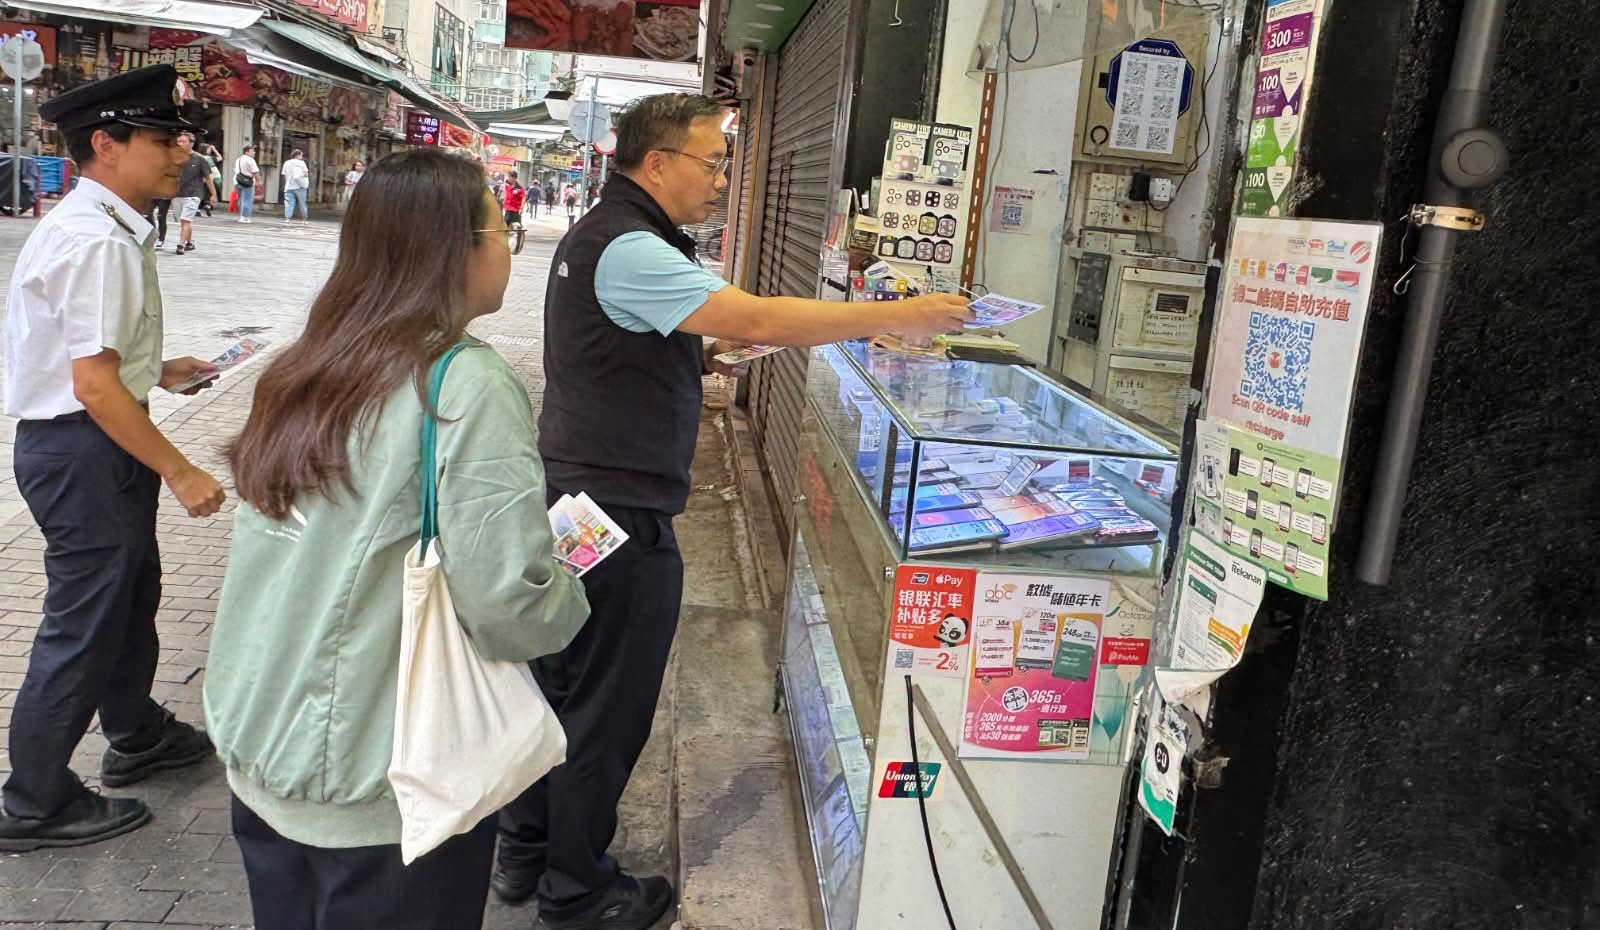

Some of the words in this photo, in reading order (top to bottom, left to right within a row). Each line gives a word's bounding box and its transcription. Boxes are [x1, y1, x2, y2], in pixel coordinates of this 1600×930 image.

[342, 2, 366, 25] SHOP
[1267, 29, 1292, 50] $300
[1258, 74, 1279, 93] $100
[1231, 393, 1250, 410] Scan
[1251, 400, 1266, 414] QR
[1266, 405, 1290, 422] code
[1290, 413, 1311, 428] self
[944, 574, 964, 588] Pay
[1231, 563, 1262, 587] Rekanan
[898, 589, 963, 609] 银联汇率
[985, 583, 1014, 600] abc
[1050, 592, 1103, 607] 儲值年卡
[896, 607, 942, 625] 补贴多
[935, 652, 959, 671] 2%
